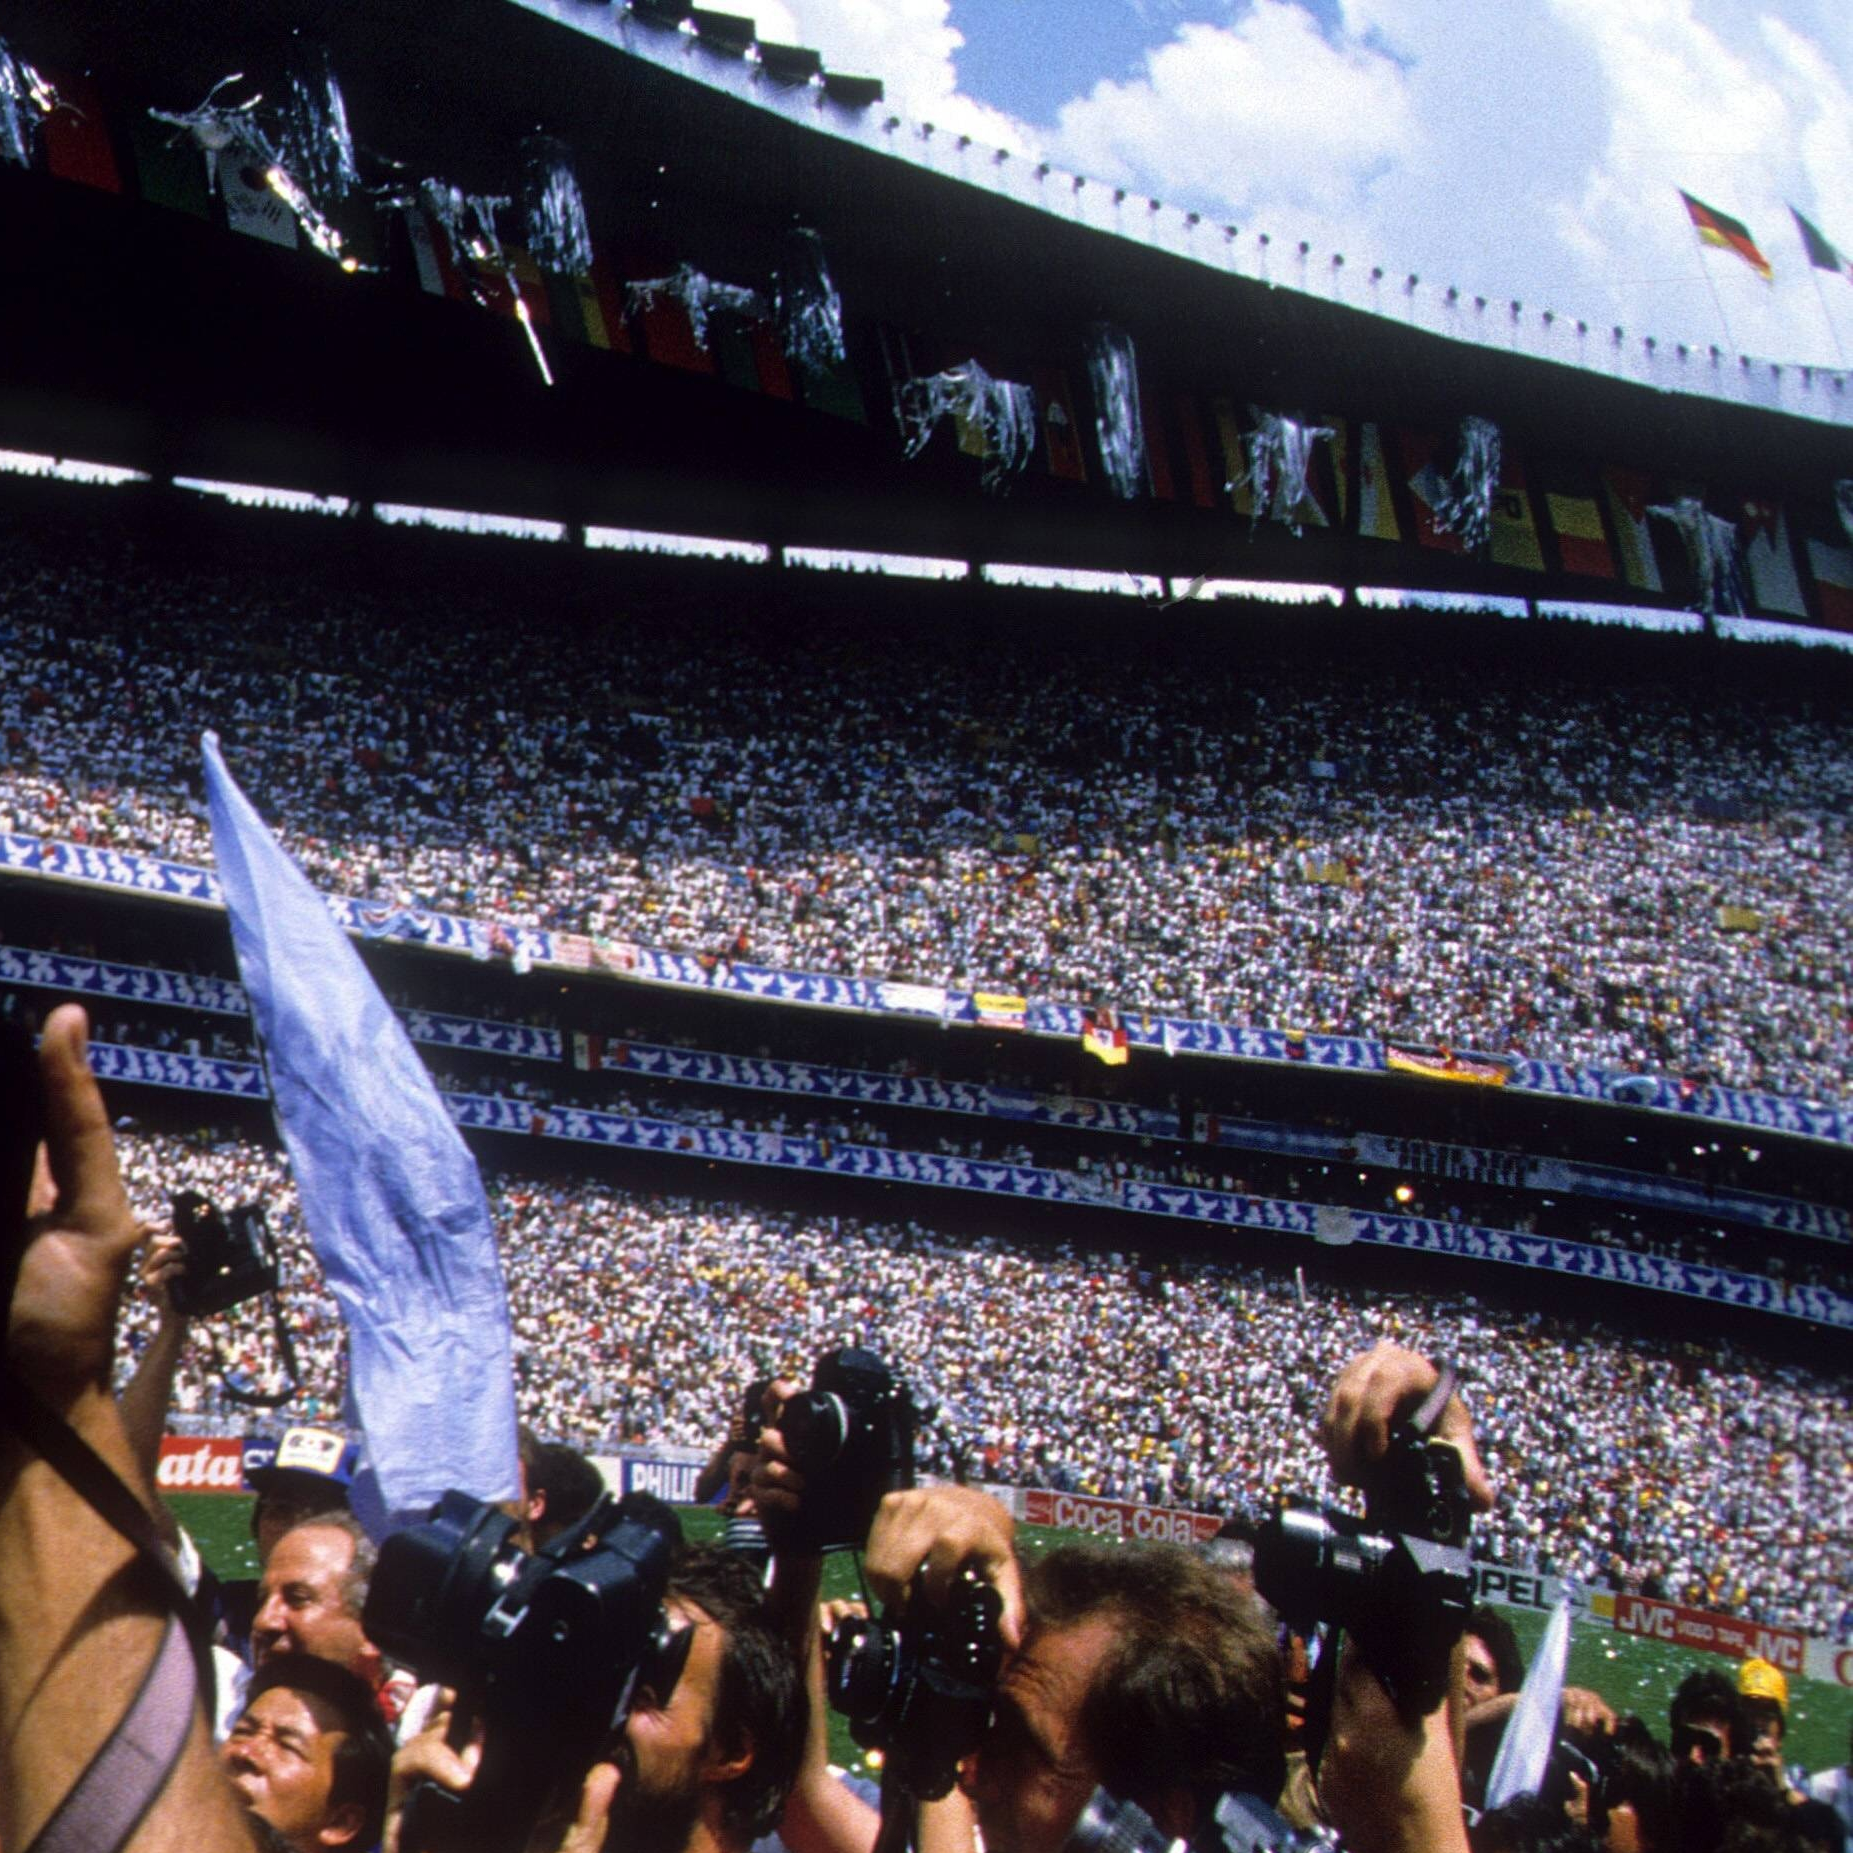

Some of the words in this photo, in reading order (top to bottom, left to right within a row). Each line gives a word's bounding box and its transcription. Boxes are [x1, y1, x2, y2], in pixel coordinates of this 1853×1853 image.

[156, 1444, 243, 1487] ata
[1055, 1497, 1192, 1546] Coca-Cola
[1479, 1570, 1554, 1612] PEL
[1619, 1602, 1675, 1639] JVC
[1746, 1629, 1801, 1669] JVC
